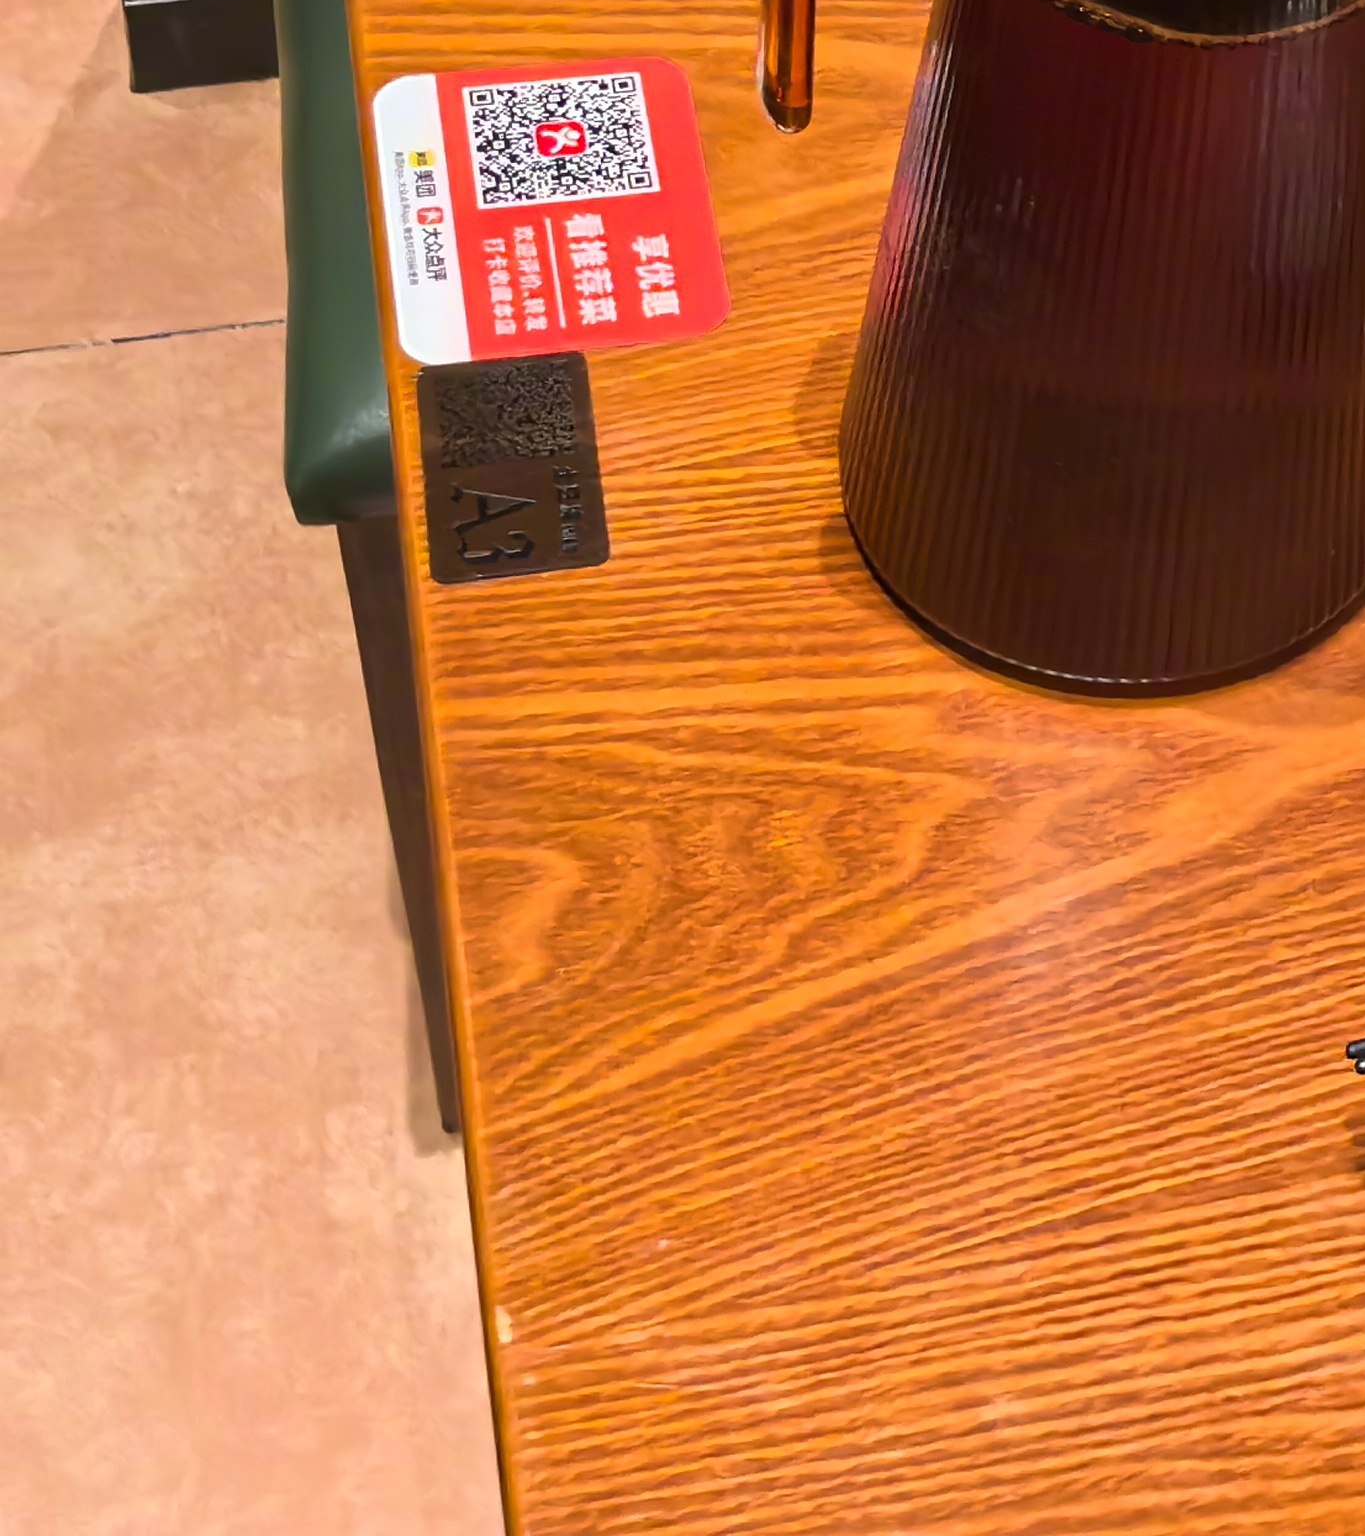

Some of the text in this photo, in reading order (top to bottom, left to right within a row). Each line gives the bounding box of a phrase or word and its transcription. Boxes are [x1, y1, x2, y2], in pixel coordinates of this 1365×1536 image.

[413, 169, 436, 198] 美团
[422, 227, 447, 282] 大众点评
[565, 213, 618, 326] 看推荐菜
[632, 233, 681, 319] 享优惠
[451, 485, 536, 562] A3
